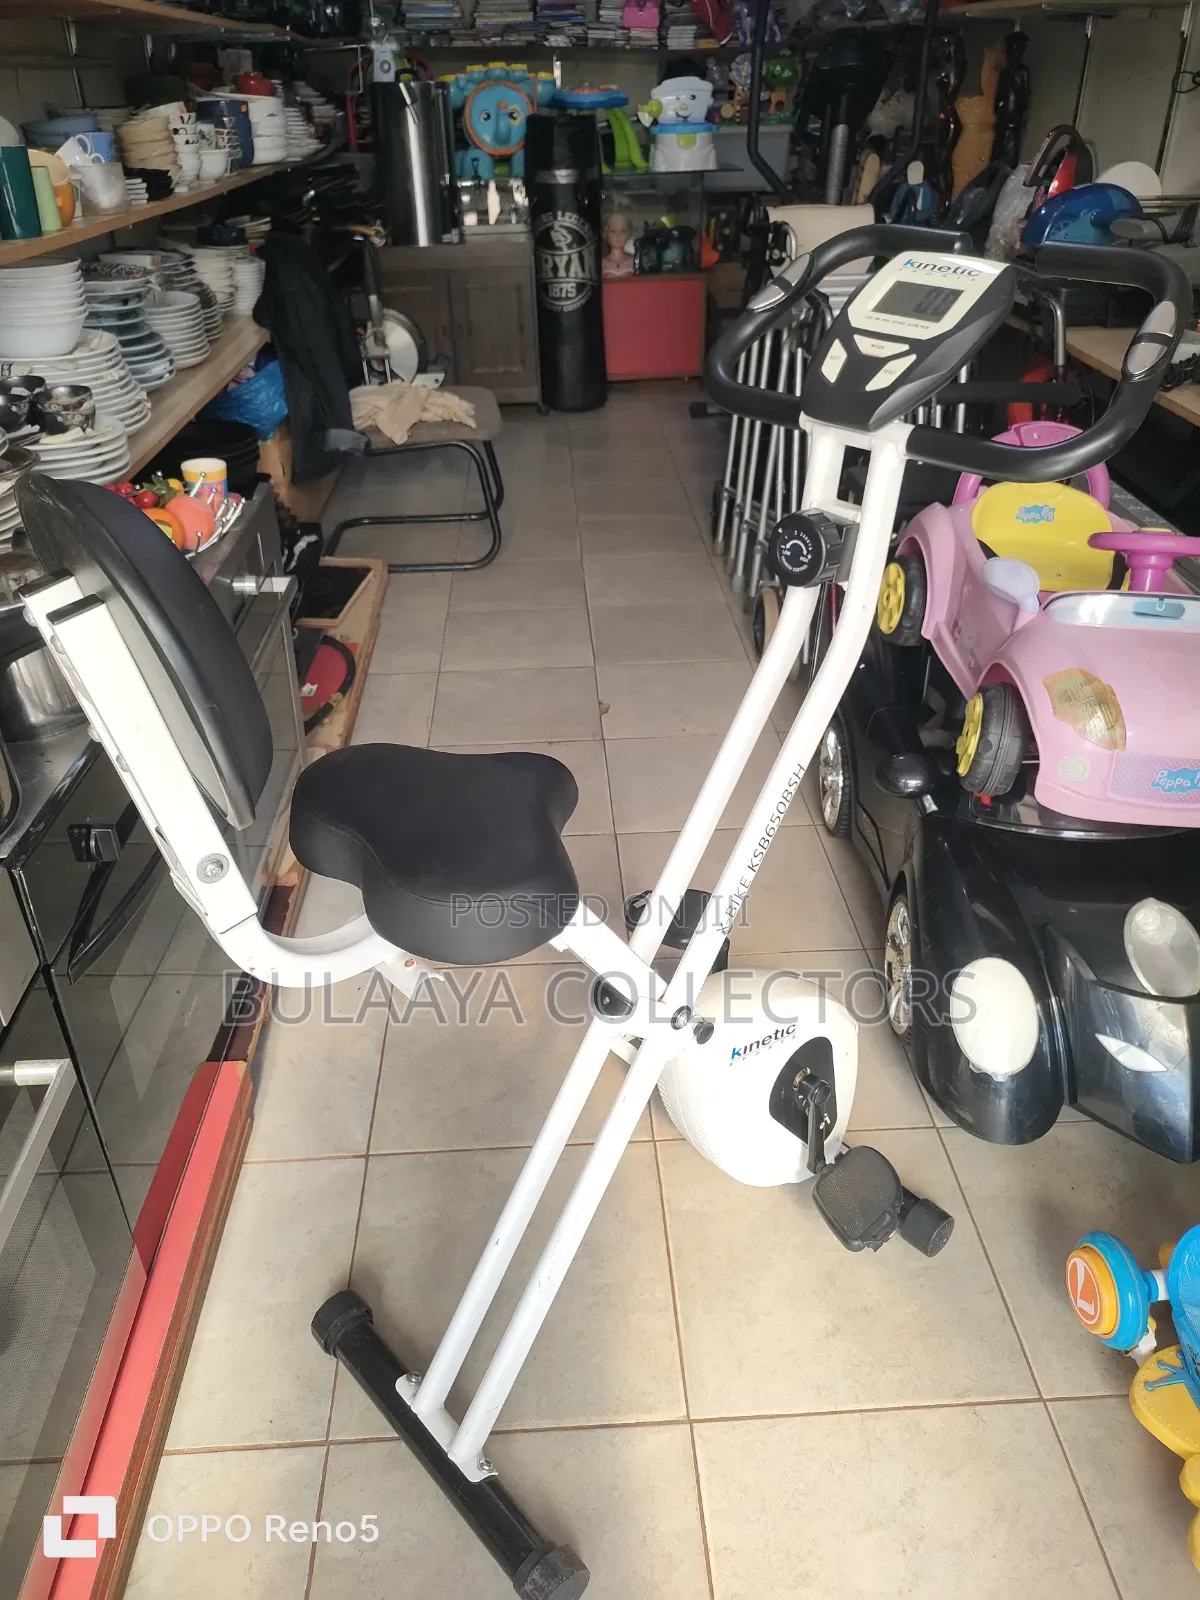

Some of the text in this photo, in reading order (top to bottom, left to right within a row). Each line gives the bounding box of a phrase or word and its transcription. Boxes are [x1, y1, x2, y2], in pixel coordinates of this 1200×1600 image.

[903, 258, 979, 277] kinetic
[1155, 769, 1191, 790] Peppa
[716, 763, 806, 936] X-BIKE KSB650BSH
[731, 1024, 797, 1060] kinetic
